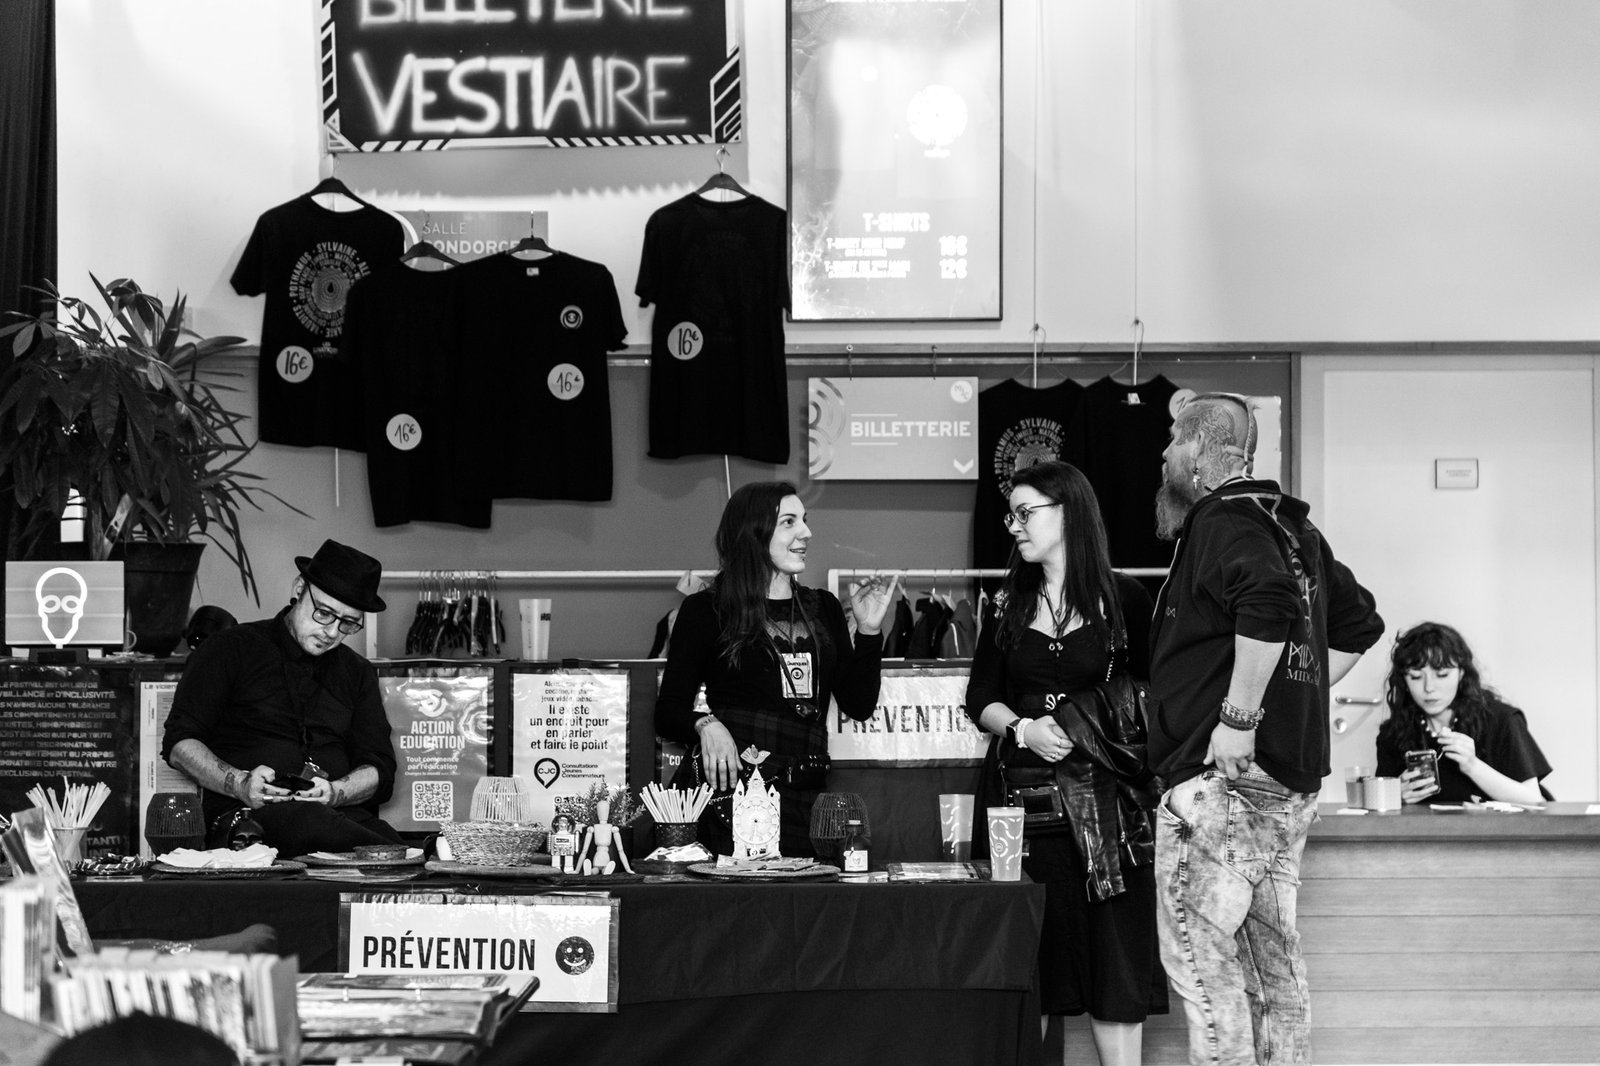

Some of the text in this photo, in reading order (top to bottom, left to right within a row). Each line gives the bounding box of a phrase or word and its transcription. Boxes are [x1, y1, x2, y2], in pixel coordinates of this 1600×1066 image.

[350, 50, 690, 135] VESTIAIRE
[422, 222, 467, 234] SALLE
[316, 241, 358, 259] SYLVAINE
[289, 251, 312, 298] POTHAMUS
[678, 328, 699, 355] 16€
[284, 351, 308, 375] 16€
[556, 372, 581, 393] 16€
[394, 422, 417, 444] 16€
[850, 420, 971, 437] BILLETTERIE
[1019, 417, 1063, 434] SYLVAINE
[994, 428, 1015, 475] POTHAMUS
[410, 720, 455, 735] ACTION
[529, 717, 543, 727] un
[586, 717, 610, 729] pour
[399, 735, 466, 749] EDUCATION
[546, 728, 593, 740] en parler
[81, 750, 115, 758] PROPOS
[530, 740, 541, 750] et
[543, 739, 567, 750] faire
[581, 740, 608, 752] point
[91, 760, 117, 768] VOTRE
[420, 763, 458, 771] l'éducation
[538, 767, 556, 775] CJC
[363, 929, 536, 971] PRÉVENTION
